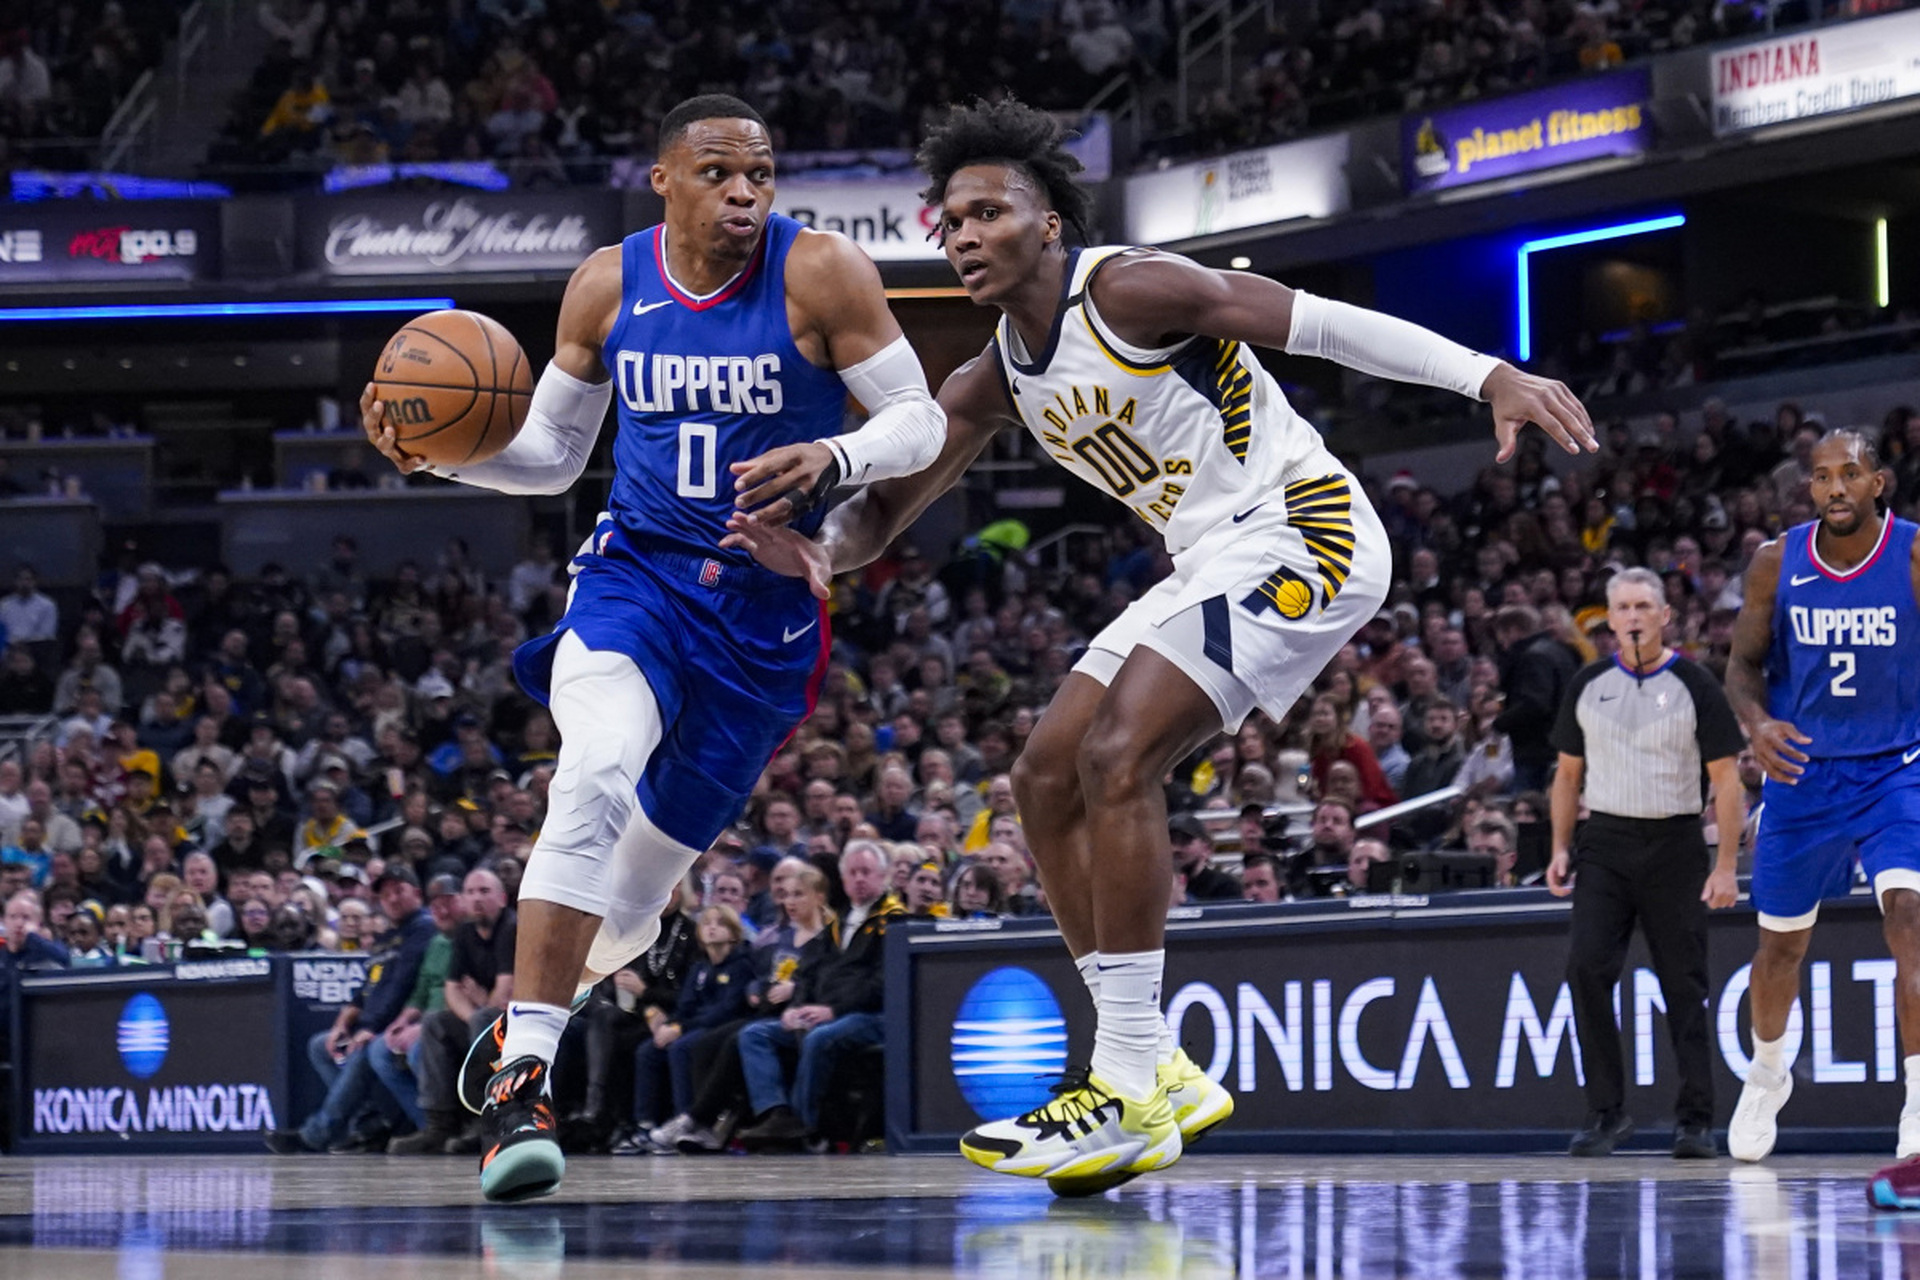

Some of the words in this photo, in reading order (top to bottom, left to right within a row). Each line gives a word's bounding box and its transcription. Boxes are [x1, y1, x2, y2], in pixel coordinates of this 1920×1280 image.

[1718, 38, 1820, 96] INDIANA
[1796, 84, 1844, 117] Credit
[1850, 76, 1898, 107] Union
[1456, 118, 1544, 174] planet
[1547, 104, 1643, 147] fitness
[788, 205, 905, 242] Bank
[616, 349, 784, 415] CLIPPERS
[1042, 384, 1138, 464] INDIANA
[676, 421, 718, 499] 0
[1071, 422, 1161, 498] 00
[1789, 605, 1897, 647] CLIPPERS
[1829, 651, 1858, 697] 2
[1166, 975, 1471, 1092] ONICA
[33, 1085, 143, 1134] KONICA
[145, 1083, 277, 1132] MINOLTA
